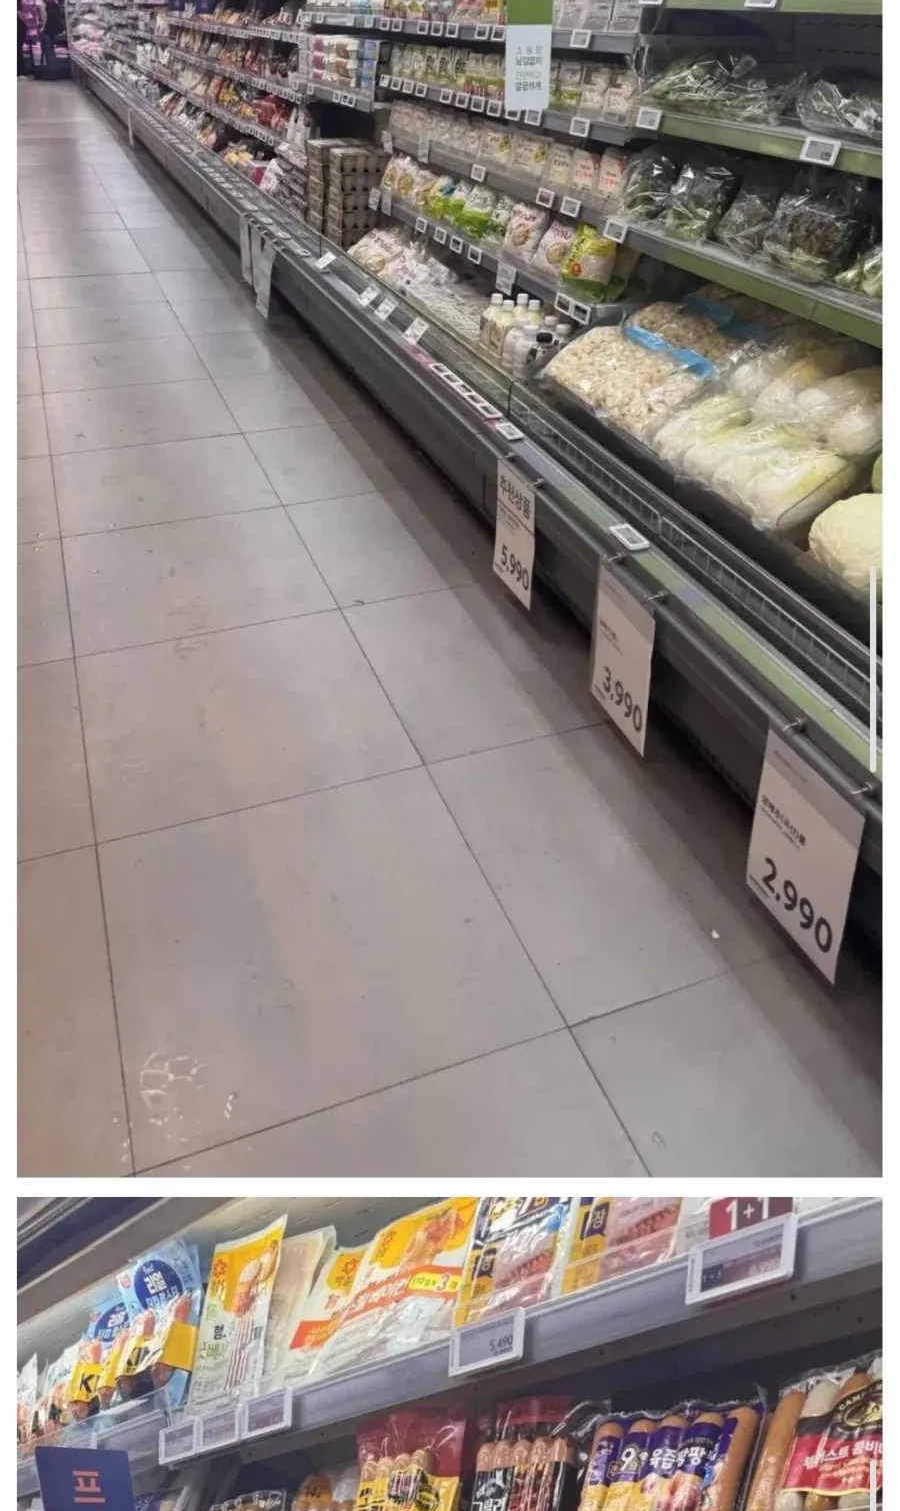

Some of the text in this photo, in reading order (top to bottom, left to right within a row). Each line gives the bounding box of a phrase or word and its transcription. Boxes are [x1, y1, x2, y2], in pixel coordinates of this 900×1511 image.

[501, 544, 530, 591] 5,990
[602, 665, 643, 733] 3,990
[762, 857, 833, 955] 2,990
